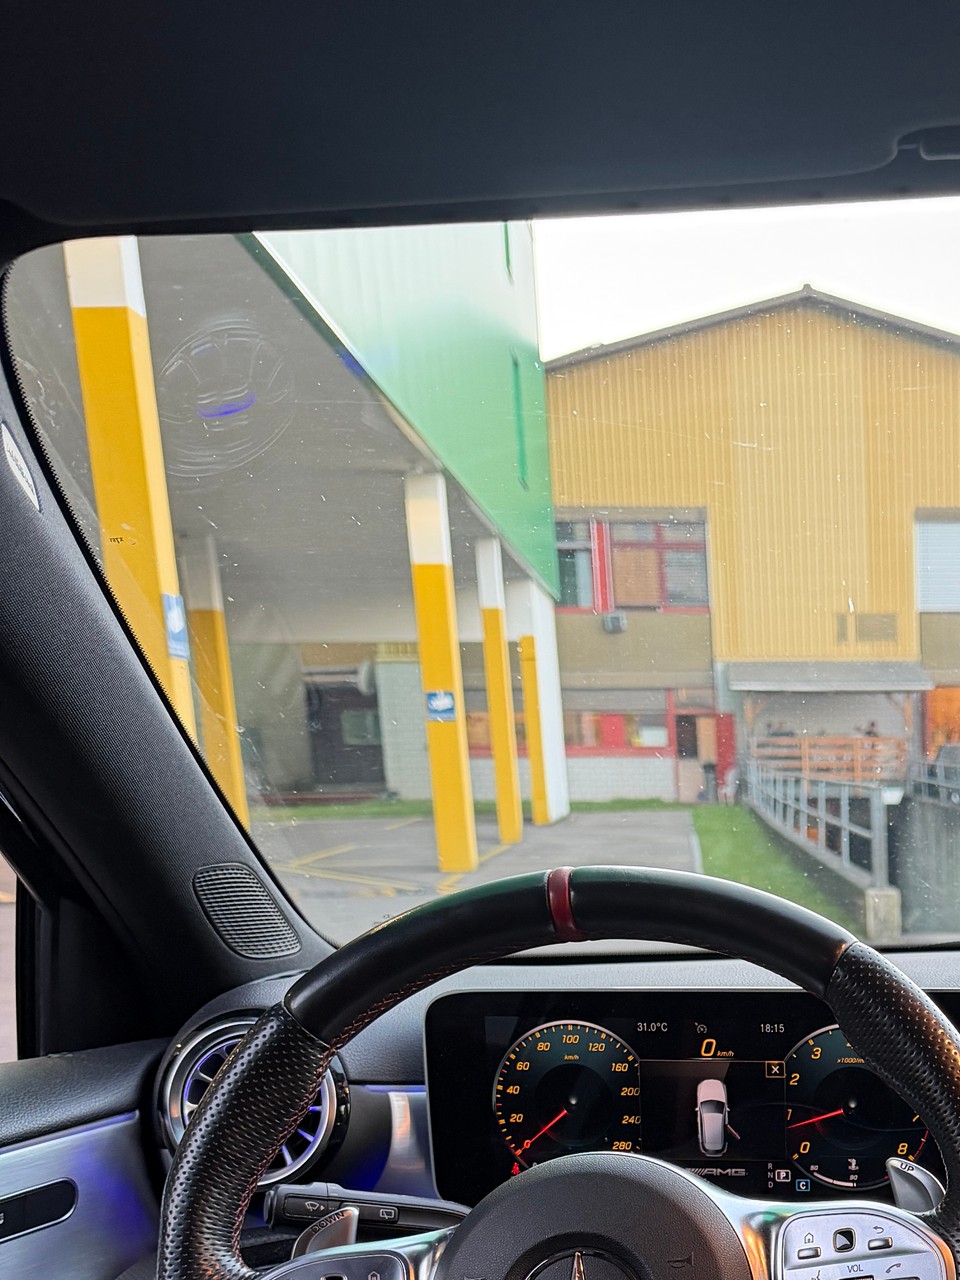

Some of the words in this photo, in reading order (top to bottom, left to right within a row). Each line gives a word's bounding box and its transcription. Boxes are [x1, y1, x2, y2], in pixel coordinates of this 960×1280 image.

[637, 1022, 668, 1032] 31.0°C
[760, 1024, 785, 1033] 18:15
[562, 1034, 580, 1044] 100
[536, 1042, 551, 1052] 80
[588, 1042, 606, 1052] 120
[701, 1039, 716, 1057] 0
[810, 1047, 822, 1060] 3
[516, 1062, 530, 1070] 60
[611, 1062, 628, 1072] 160
[789, 1073, 800, 1086] 2
[506, 1085, 520, 1094] 40
[620, 1088, 640, 1096] 200
[510, 1114, 524, 1122] 20
[786, 1108, 792, 1120] 1
[622, 1116, 641, 1124] 240
[523, 1140, 531, 1148] 0
[612, 1142, 632, 1150] 280
[800, 1142, 810, 1154] 0
[897, 1142, 908, 1154] 8
[899, 1162, 916, 1173] UP
[310, 1211, 345, 1234] DOWN
[847, 1264, 864, 1274] VOL
